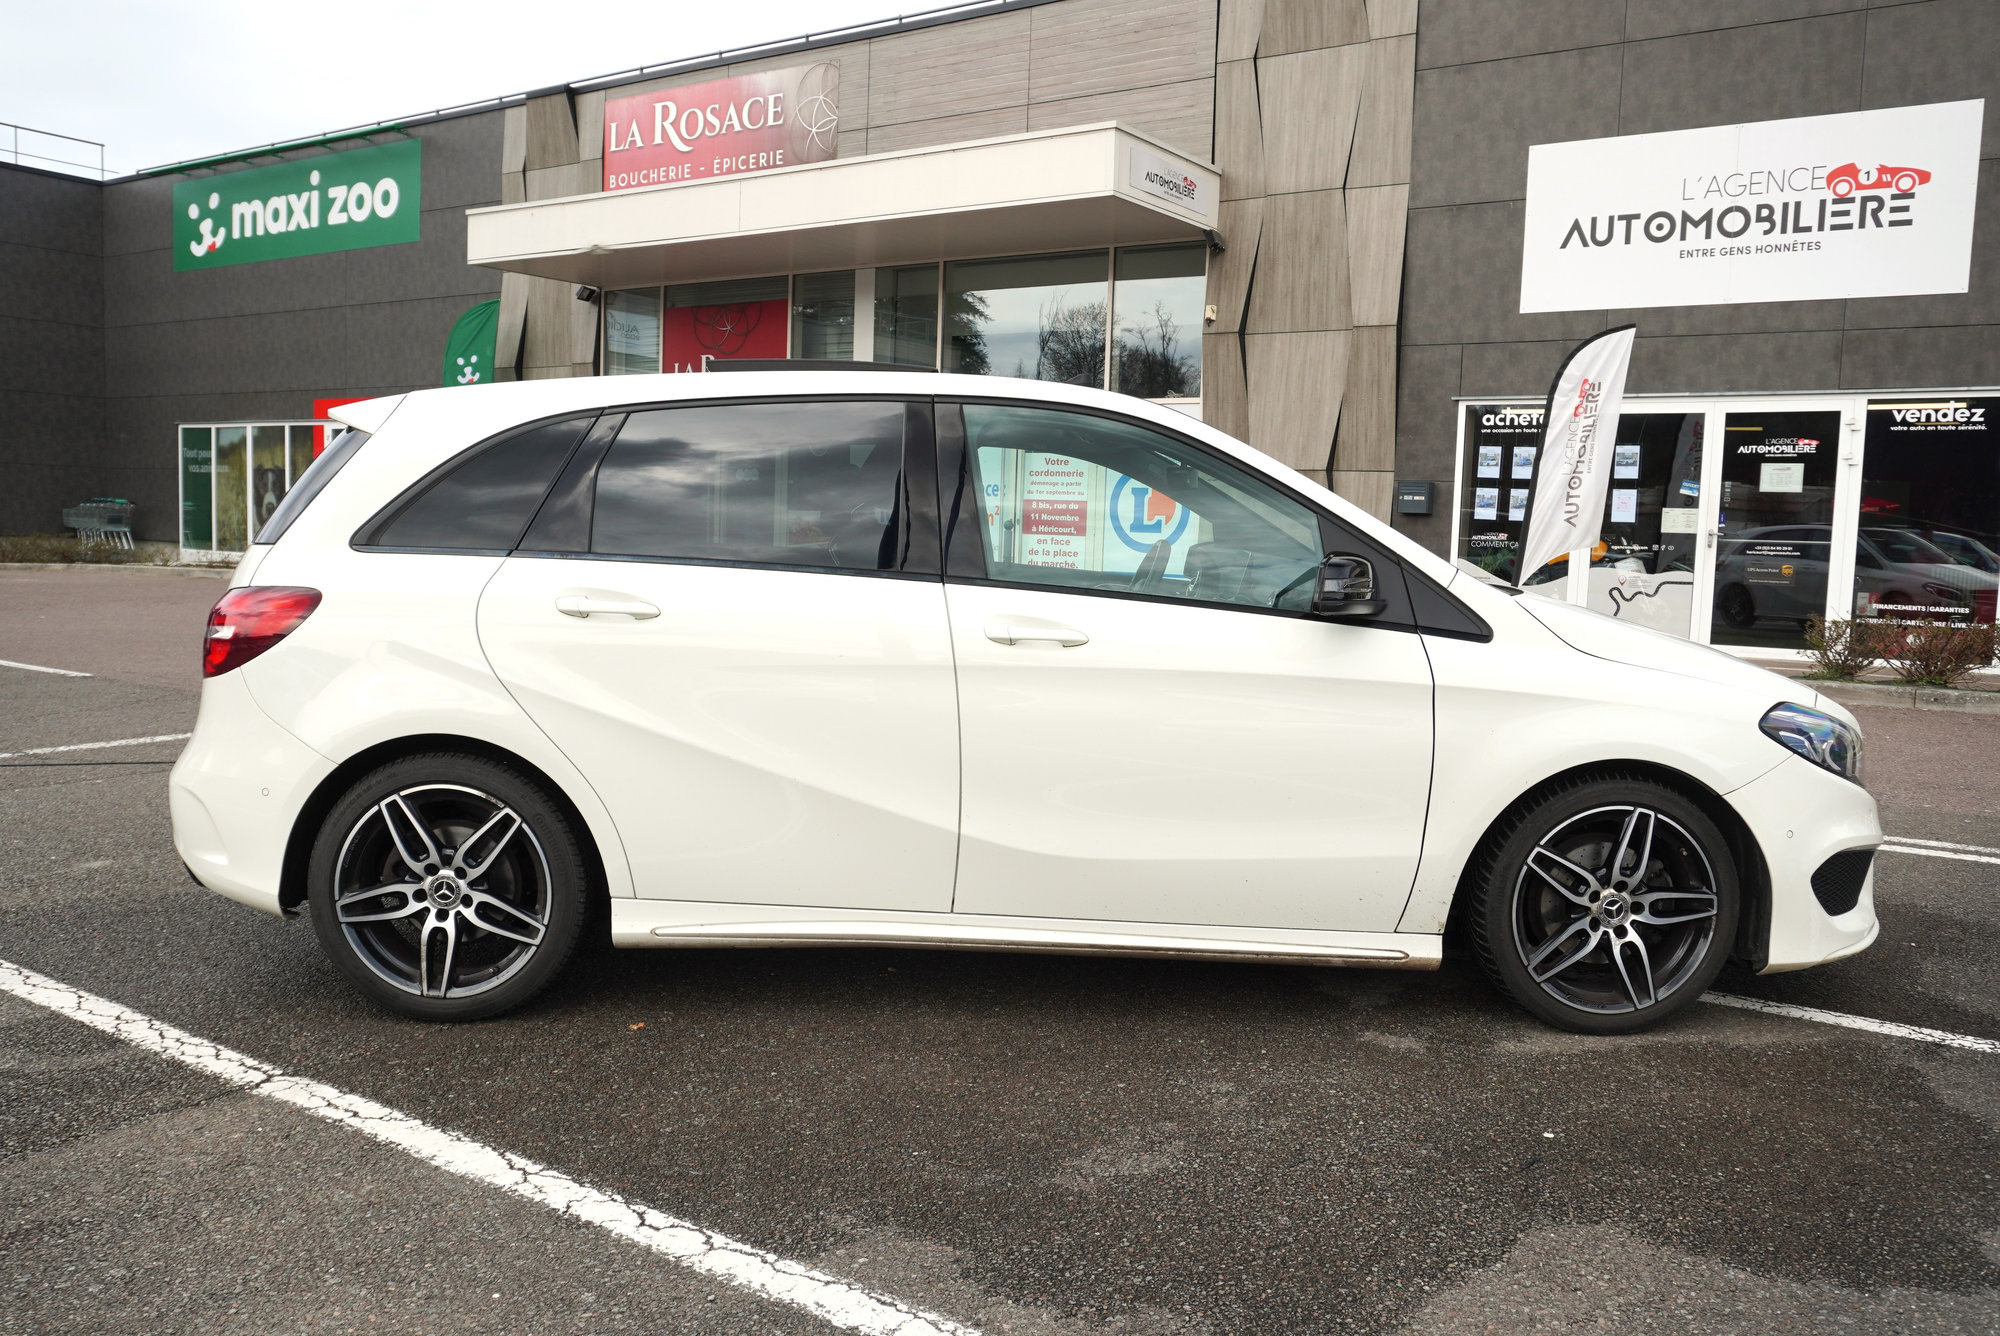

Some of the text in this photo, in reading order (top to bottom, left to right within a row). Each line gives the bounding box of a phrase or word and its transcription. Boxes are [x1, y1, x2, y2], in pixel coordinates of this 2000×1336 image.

[609, 93, 785, 152] LA ROSACE
[609, 163, 692, 188] BOUCHERIE
[713, 150, 784, 174] ÉPICERIE
[1682, 165, 1828, 201] L'AGENCE
[231, 170, 400, 240] maxi zoo
[1679, 240, 1822, 259] ENTRE GENS HONNÊTES
[1892, 400, 1986, 423] vendez
[198, 450, 212, 460] pou
[1045, 457, 1070, 466] Votre
[201, 462, 229, 472] aniaux
[1029, 469, 1084, 477] cordonnerie
[985, 483, 999, 497] ce
[1031, 501, 1036, 509] 8
[1038, 502, 1052, 510] bis,
[1130, 487, 1162, 533] L
[1041, 513, 1079, 522] Novembre
[1031, 524, 1077, 534] à Héricourt,
[1050, 537, 1071, 545] face
[1471, 540, 1519, 549] COMMENT ÇA
[1028, 548, 1079, 558] de la place
[1028, 558, 1039, 566] du
[1872, 603, 1970, 614] FINANCEMENTS GARANTIES
